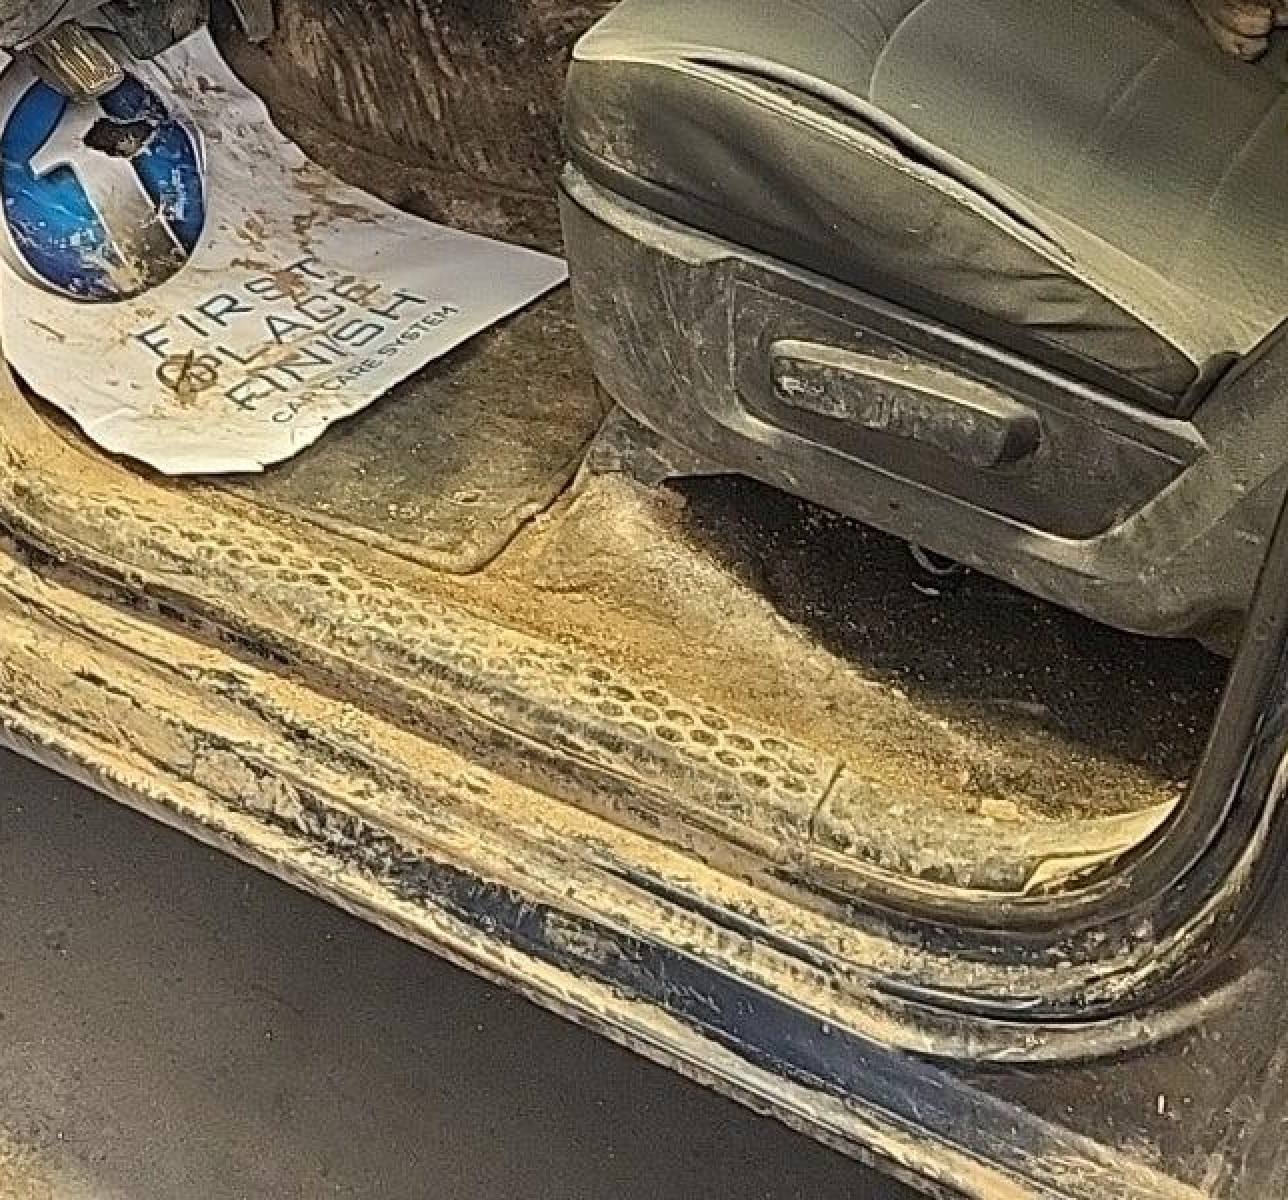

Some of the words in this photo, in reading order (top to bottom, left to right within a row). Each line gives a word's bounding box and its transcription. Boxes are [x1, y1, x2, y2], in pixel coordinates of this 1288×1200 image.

[135, 256, 326, 359] FIRST
[225, 291, 427, 411] FINISH
[377, 303, 460, 358] SYSTEM
